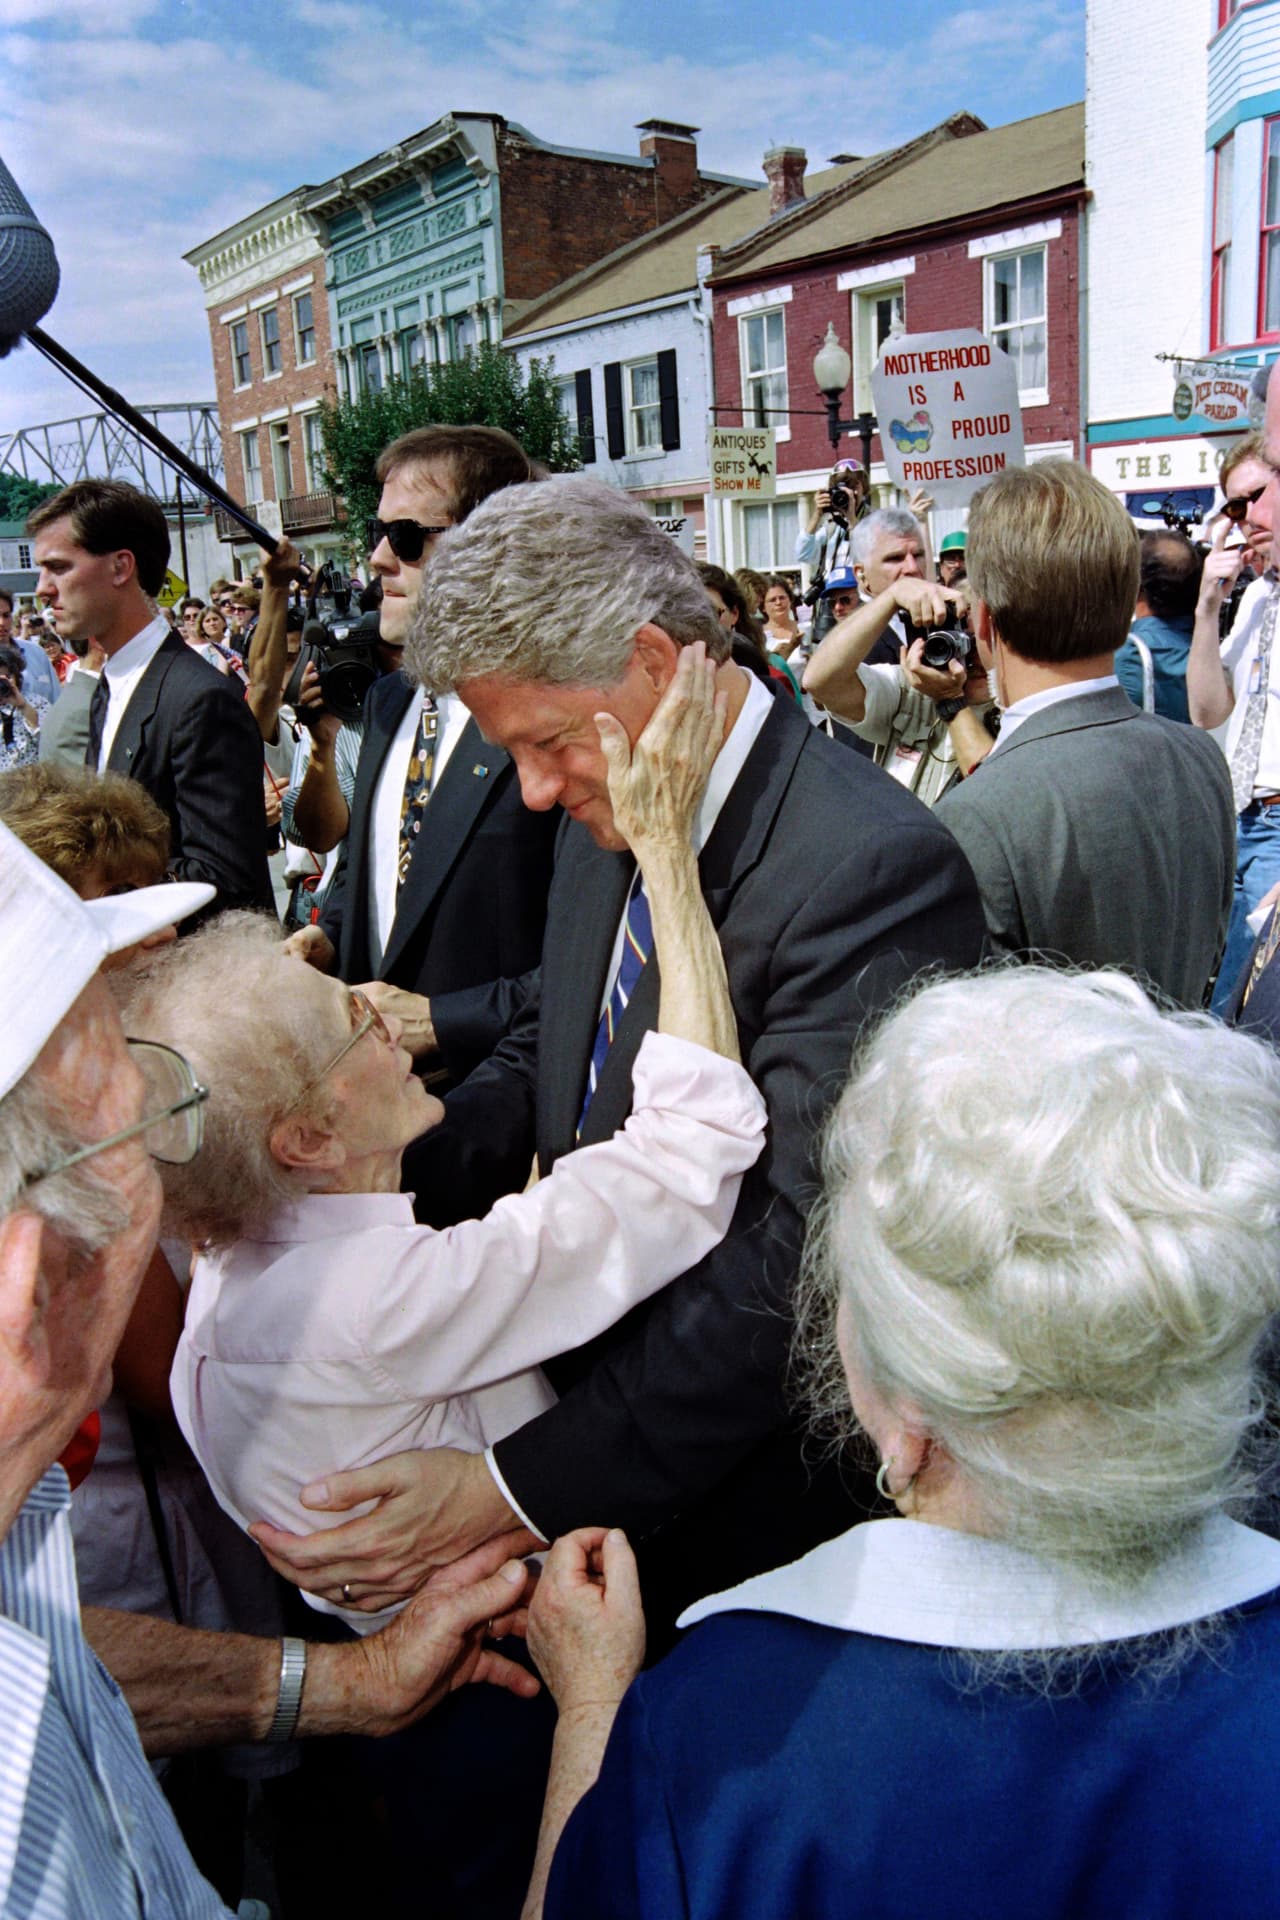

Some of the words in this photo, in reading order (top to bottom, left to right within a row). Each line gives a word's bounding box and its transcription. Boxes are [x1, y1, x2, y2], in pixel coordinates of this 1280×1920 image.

[884, 345, 991, 376] MOTHERHOOD
[908, 385, 927, 405] IS
[953, 381, 965, 402] A
[1195, 381, 1212, 408] ICE
[1213, 381, 1249, 409] CREAM
[1204, 403, 1238, 420] PARLOR
[952, 414, 1011, 440] PROUD
[713, 435, 766, 452] ANTIQUES
[714, 461, 745, 474] GIFTS
[903, 453, 1006, 481] PROFESSION
[1116, 454, 1172, 479] THE
[714, 477, 744, 490] SHOW
[747, 478, 761, 490] ME
